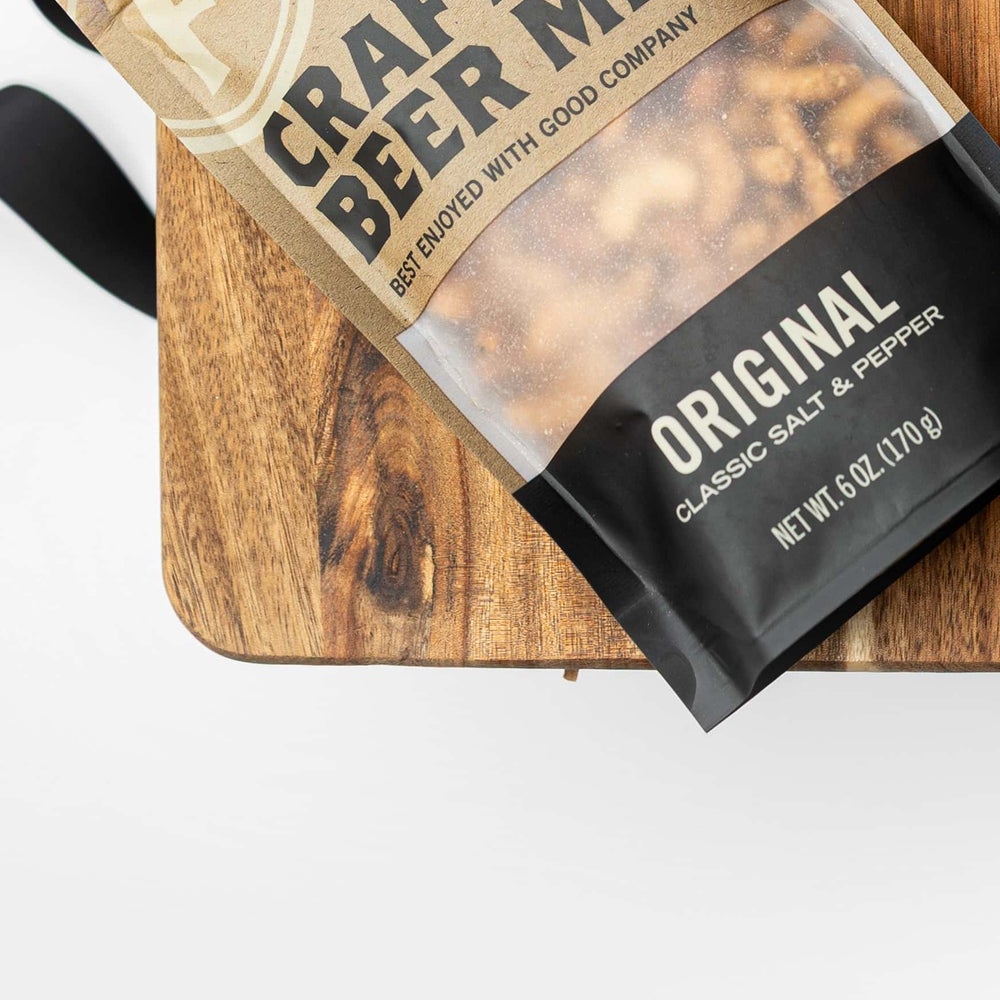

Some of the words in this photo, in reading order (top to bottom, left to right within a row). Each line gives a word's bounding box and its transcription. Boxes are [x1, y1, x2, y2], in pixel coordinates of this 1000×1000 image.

[316, 44, 530, 265] BEER
[389, 250, 423, 298] BEST
[418, 182, 485, 258] ENJOYED
[482, 133, 537, 184] WITH
[539, 84, 599, 137] GOOD
[599, 5, 700, 89] COMPANY
[651, 270, 900, 474] ORIGINAL
[676, 441, 767, 523] CLASSIC
[768, 390, 825, 445] SALT
[831, 376, 854, 397] &
[851, 305, 945, 379] PEPPER
[770, 506, 811, 550] NET
[803, 485, 844, 523] WT.
[835, 474, 857, 498] 6
[849, 454, 885, 488] OZ.
